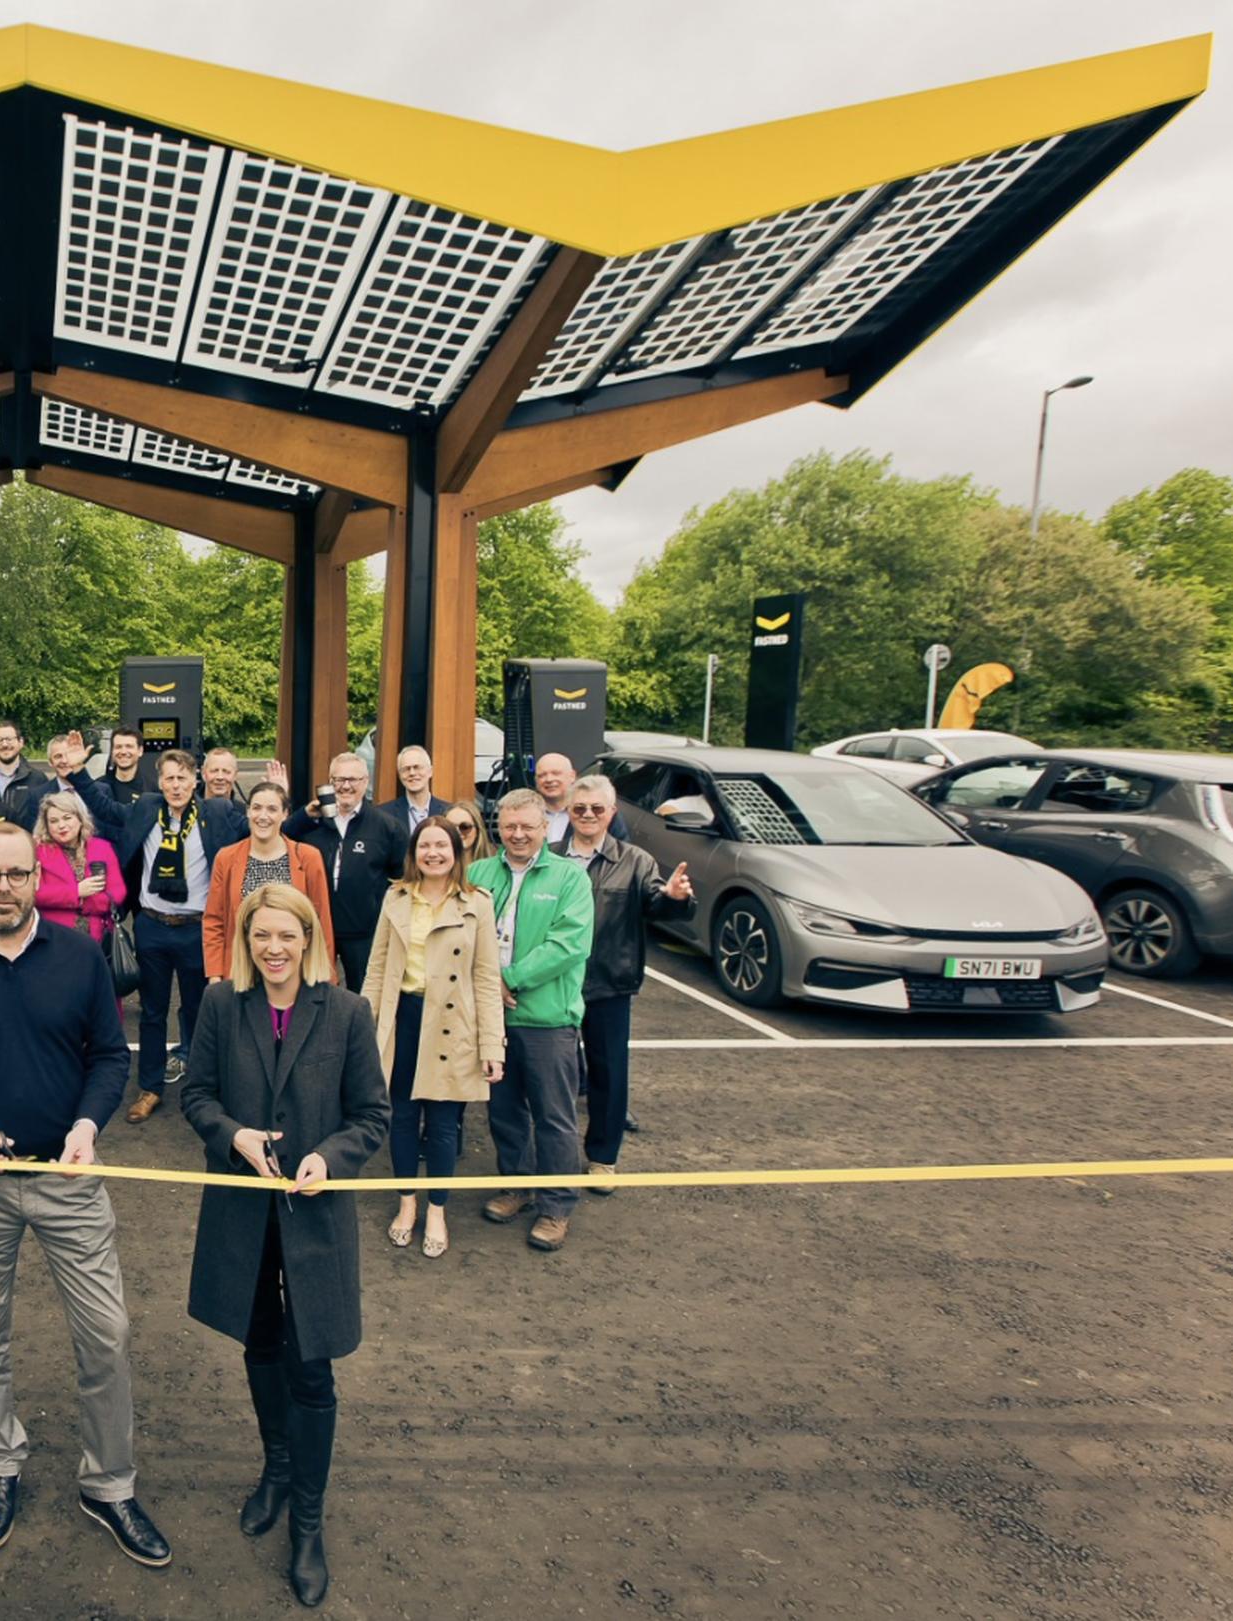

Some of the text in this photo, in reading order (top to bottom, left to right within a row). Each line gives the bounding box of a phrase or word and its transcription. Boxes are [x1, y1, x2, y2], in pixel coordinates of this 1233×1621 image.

[553, 702, 586, 710] FASTNED
[959, 960, 1034, 976] SN71 BWU
